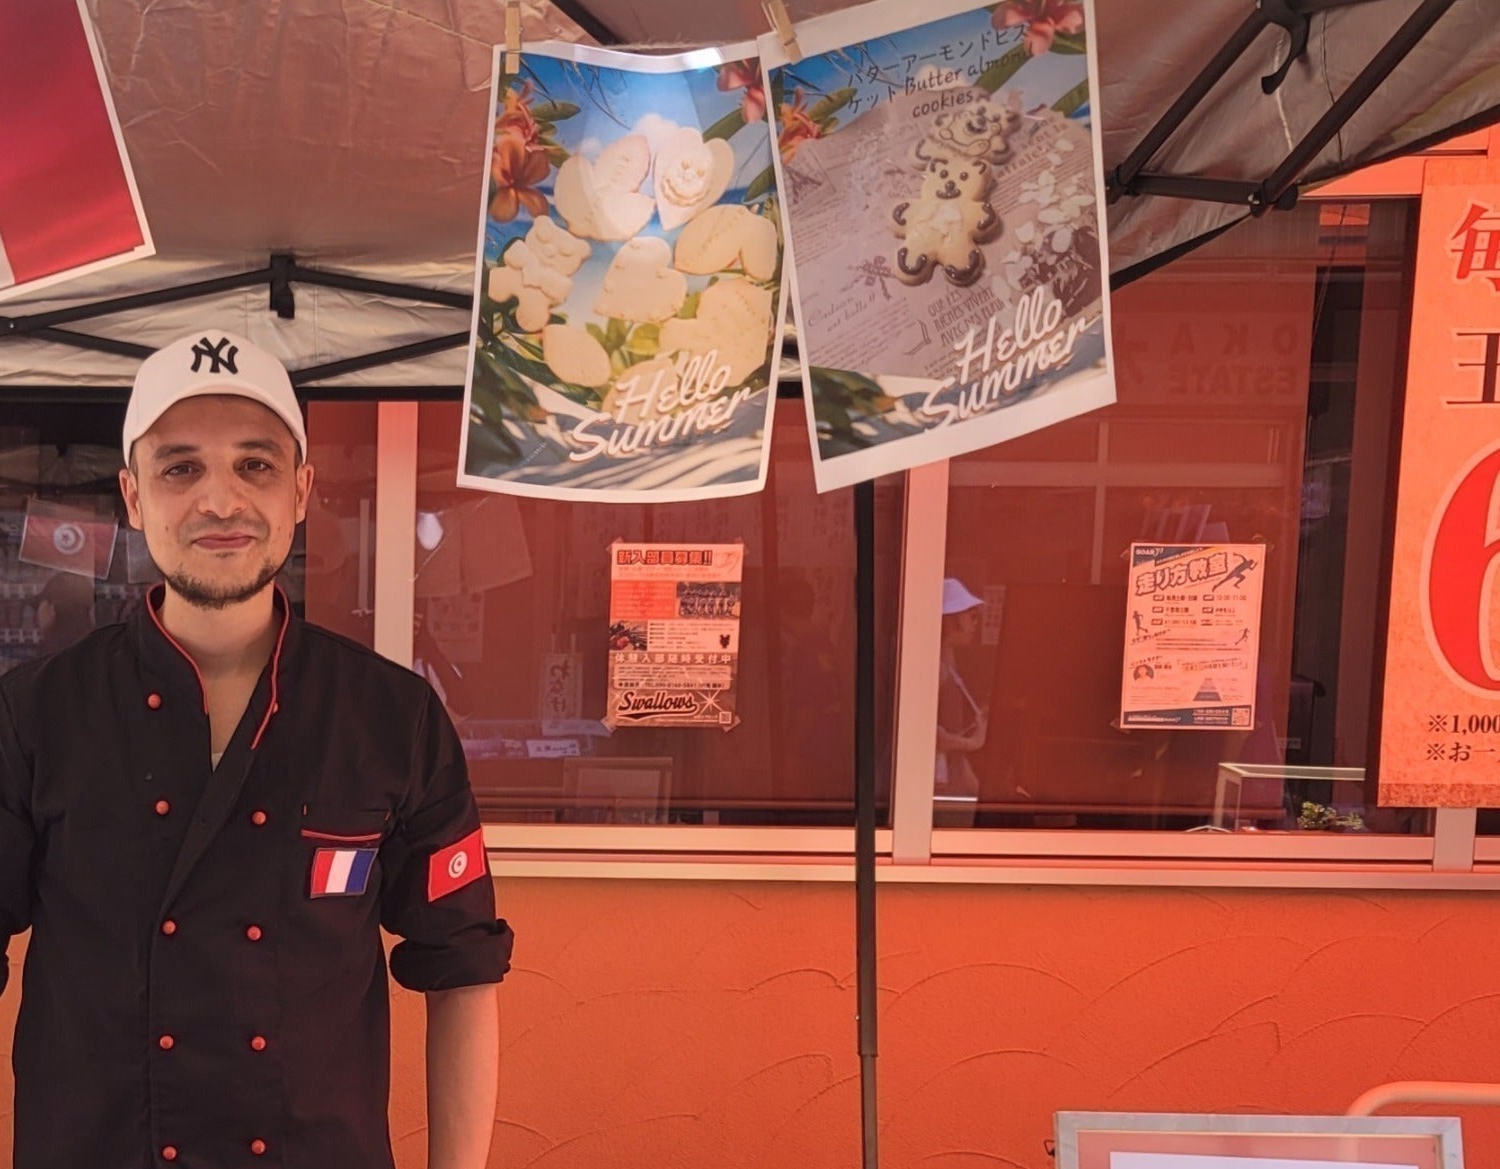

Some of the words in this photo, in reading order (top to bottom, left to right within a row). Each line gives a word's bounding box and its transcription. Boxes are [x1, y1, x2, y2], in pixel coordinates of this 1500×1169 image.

[904, 67, 963, 97] Butter
[912, 89, 974, 119] cookies
[191, 337, 239, 375] NY
[954, 286, 1063, 386] Hello
[616, 349, 732, 424] Hello
[923, 313, 1102, 434] Summer
[568, 386, 752, 462] Summer
[618, 690, 697, 713] Swallows
